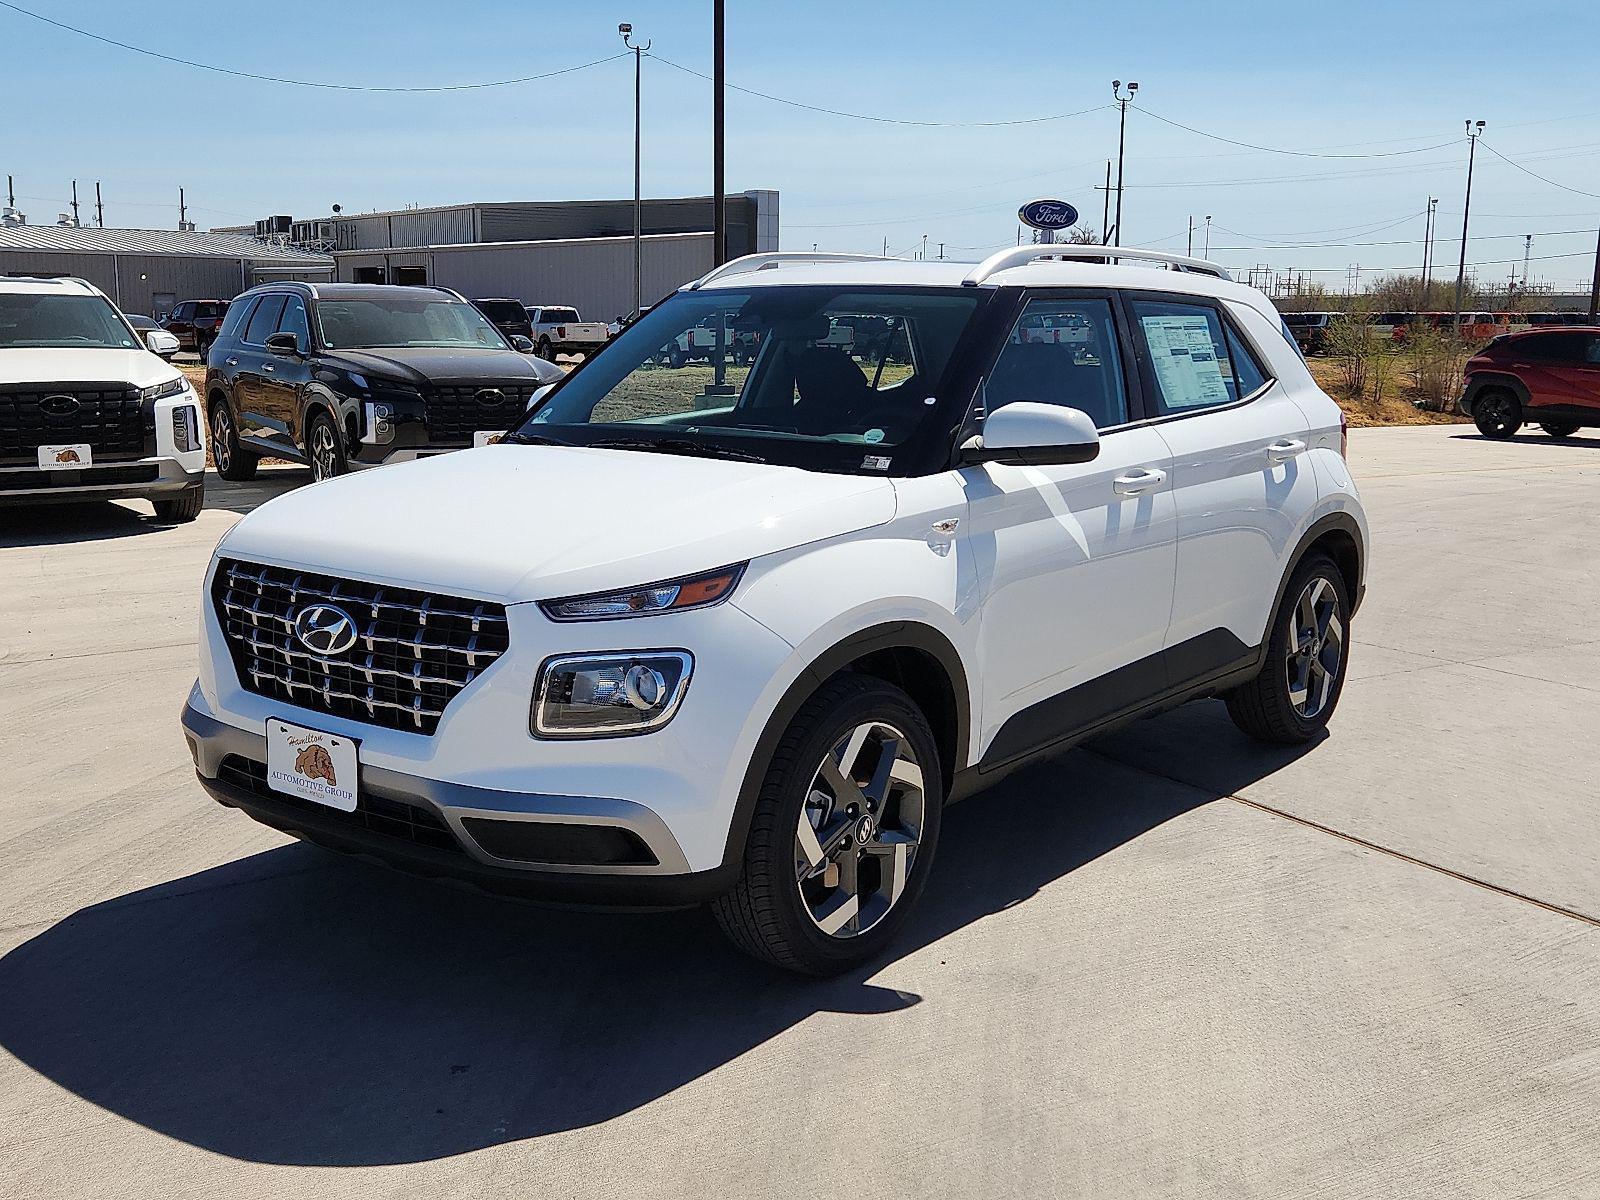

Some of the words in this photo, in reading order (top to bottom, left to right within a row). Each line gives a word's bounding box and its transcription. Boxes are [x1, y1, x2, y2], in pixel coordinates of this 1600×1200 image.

[1036, 204, 1068, 223] Ford
[287, 733, 324, 747] Hamilton
[271, 770, 324, 792] AUTOMOTIVE
[324, 785, 353, 800] GROUP
